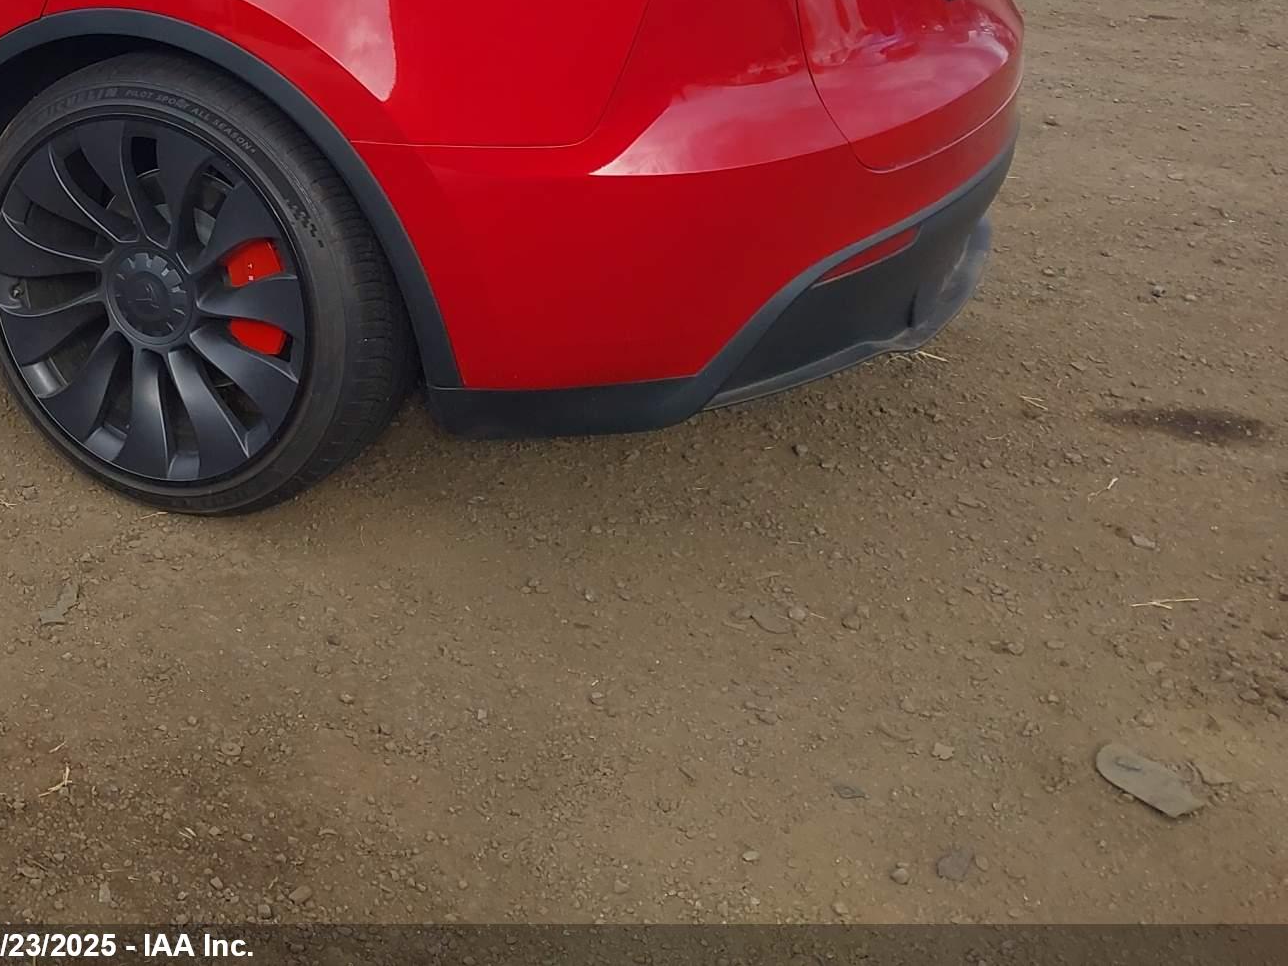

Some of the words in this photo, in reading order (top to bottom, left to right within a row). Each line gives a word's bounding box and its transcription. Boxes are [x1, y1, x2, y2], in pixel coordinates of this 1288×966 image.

[124, 89, 154, 99] PILOT
[155, 94, 191, 109] SPORT
[192, 106, 210, 121] ALL
